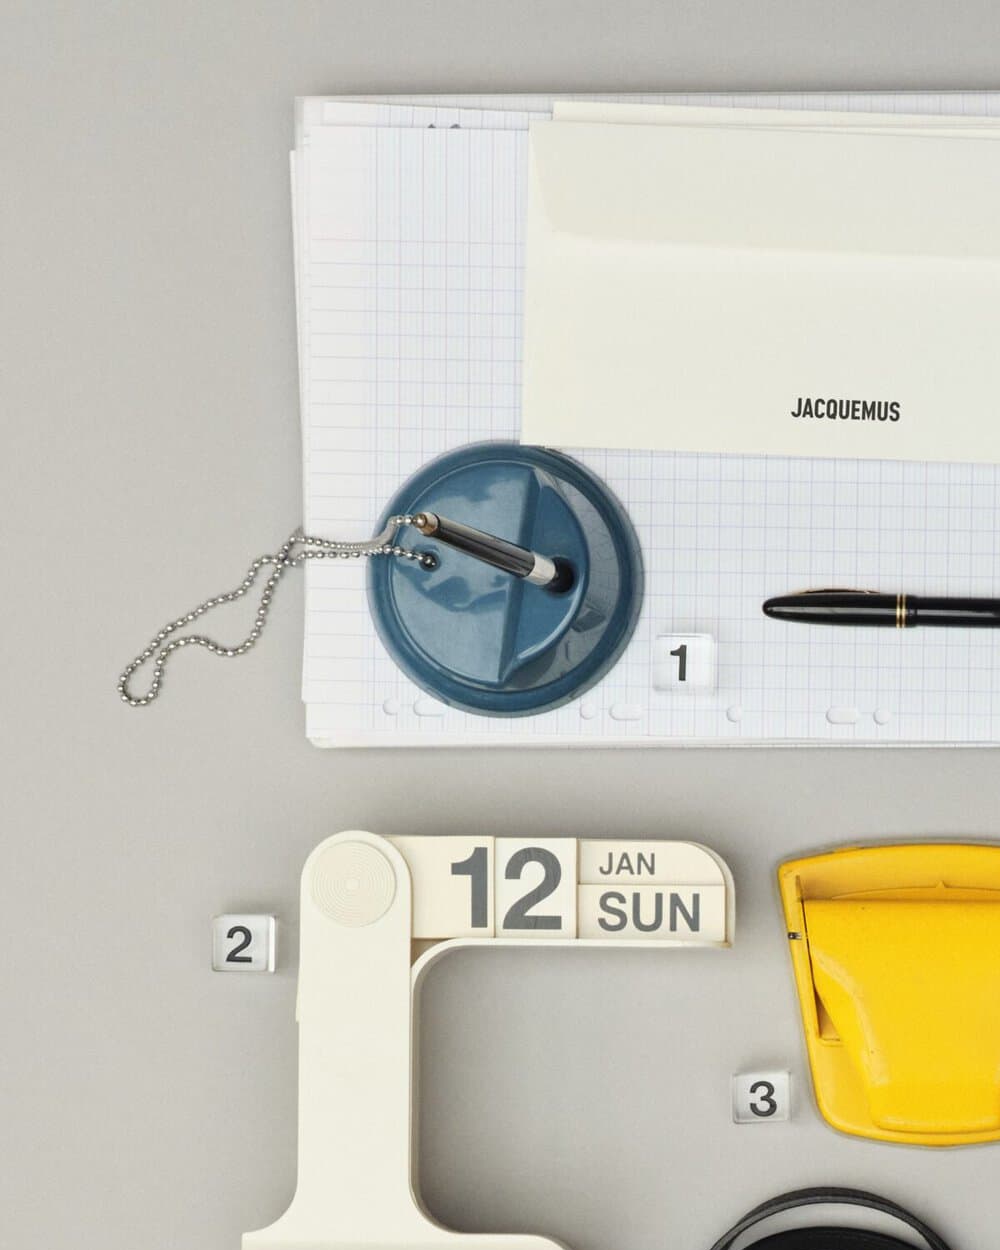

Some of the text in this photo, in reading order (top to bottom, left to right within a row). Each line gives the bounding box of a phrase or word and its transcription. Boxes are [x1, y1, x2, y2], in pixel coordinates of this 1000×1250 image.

[791, 398, 900, 422] JACQUEMUS
[670, 645, 688, 682] 1
[599, 852, 656, 876] JAN
[451, 846, 563, 931] 12
[598, 892, 700, 932] SUN
[226, 926, 252, 963] 2
[749, 1081, 777, 1117] 3
